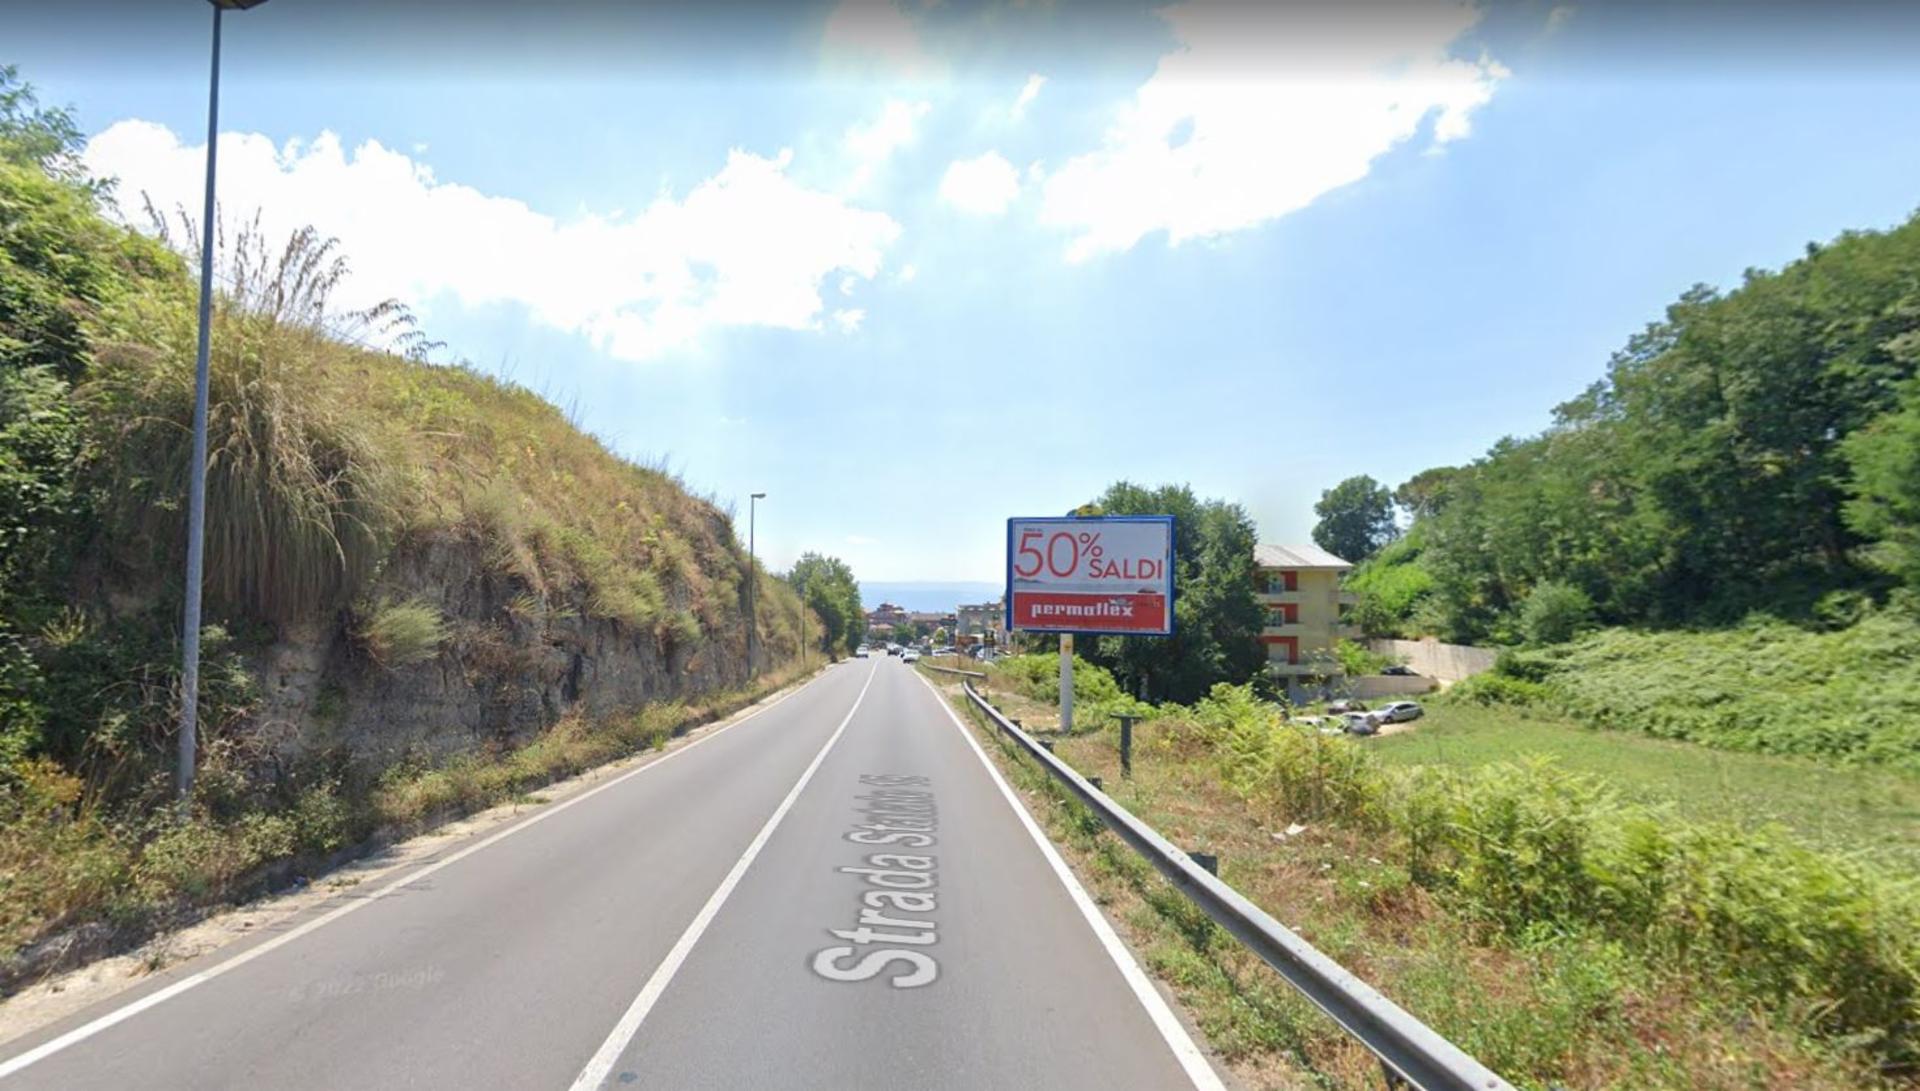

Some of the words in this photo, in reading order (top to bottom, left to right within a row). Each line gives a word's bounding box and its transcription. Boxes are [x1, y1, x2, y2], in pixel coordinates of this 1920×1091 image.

[1014, 532, 1103, 577] 50%
[1088, 559, 1163, 580] SALDI
[1031, 600, 1133, 618] permaflex
